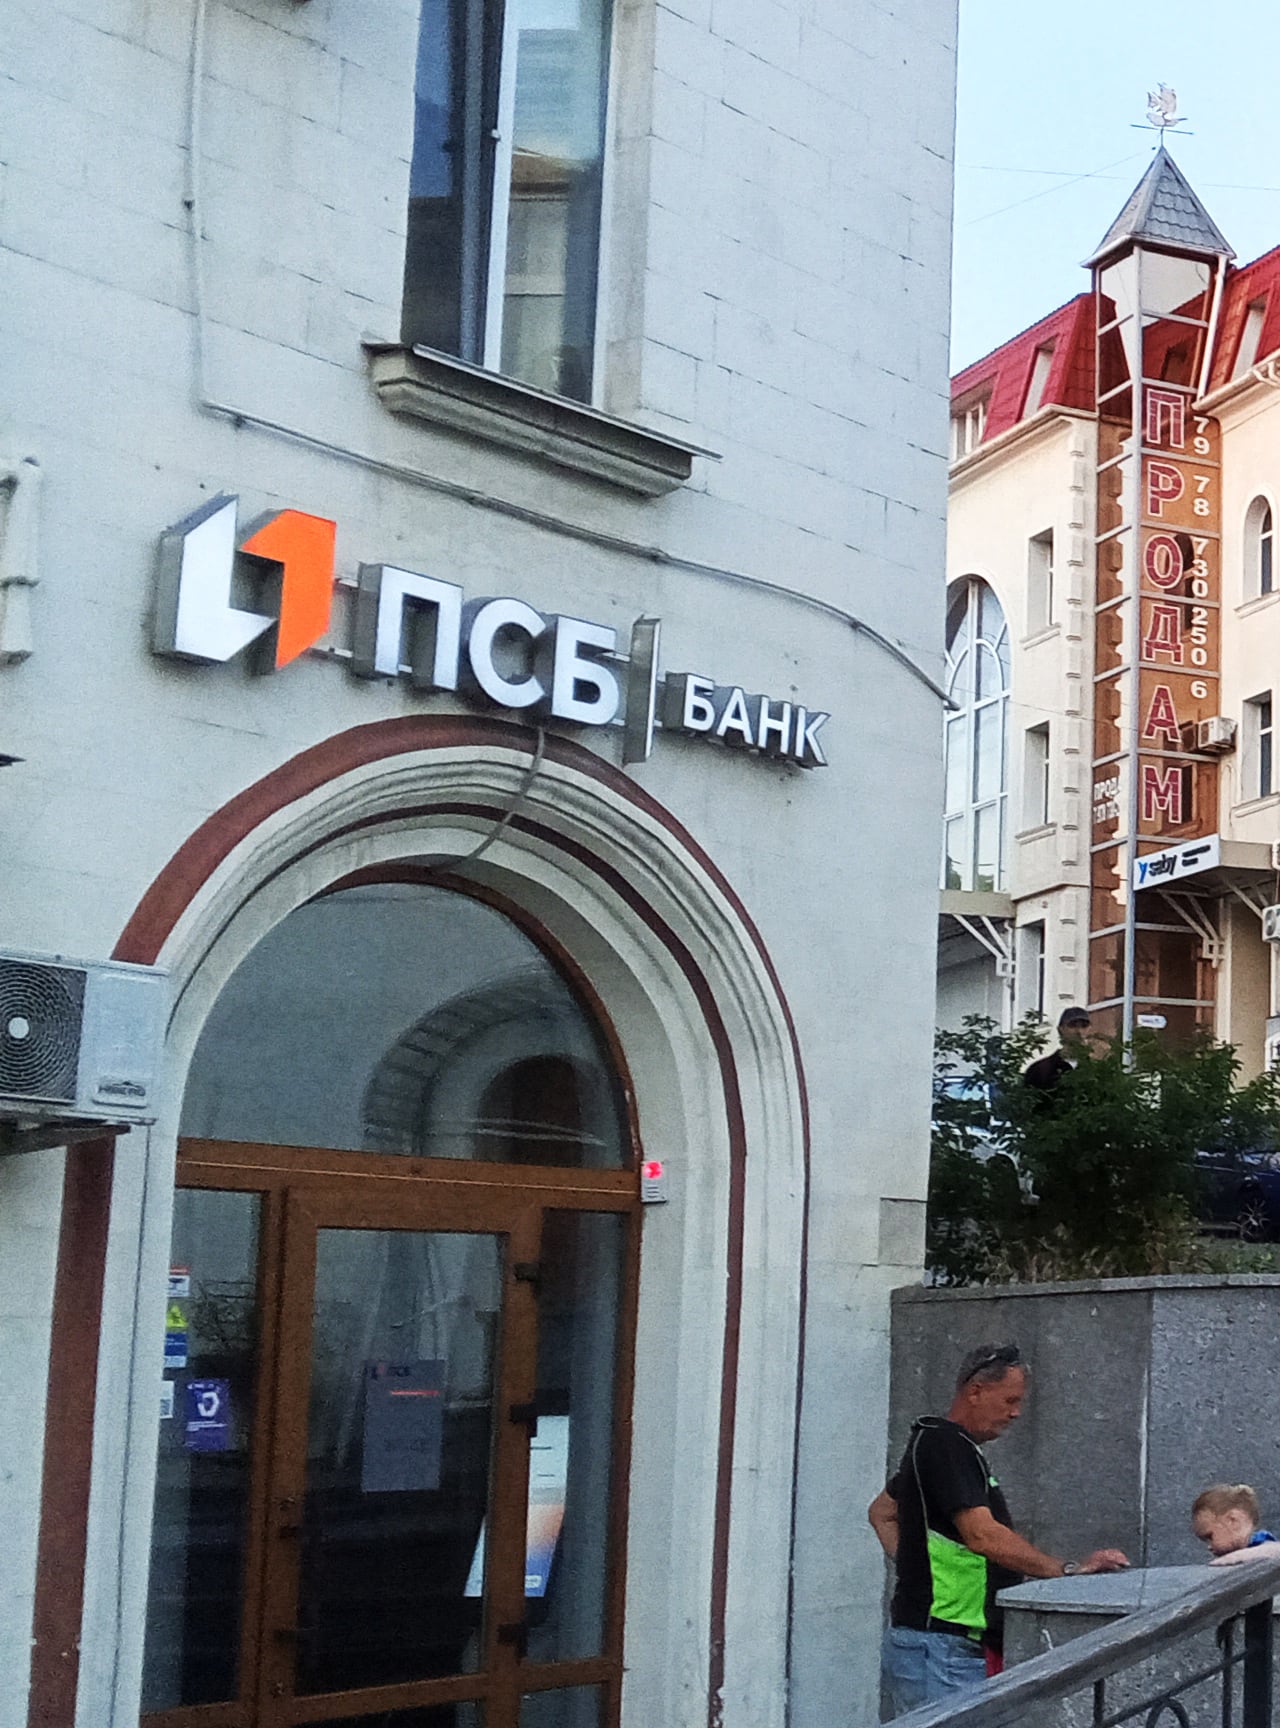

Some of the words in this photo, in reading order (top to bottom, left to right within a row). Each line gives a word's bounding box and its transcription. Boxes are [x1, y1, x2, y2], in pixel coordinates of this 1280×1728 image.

[373, 565, 620, 726] ПСБ
[681, 673, 831, 767] БАНК
[1142, 387, 1186, 824] ПРОДАМ
